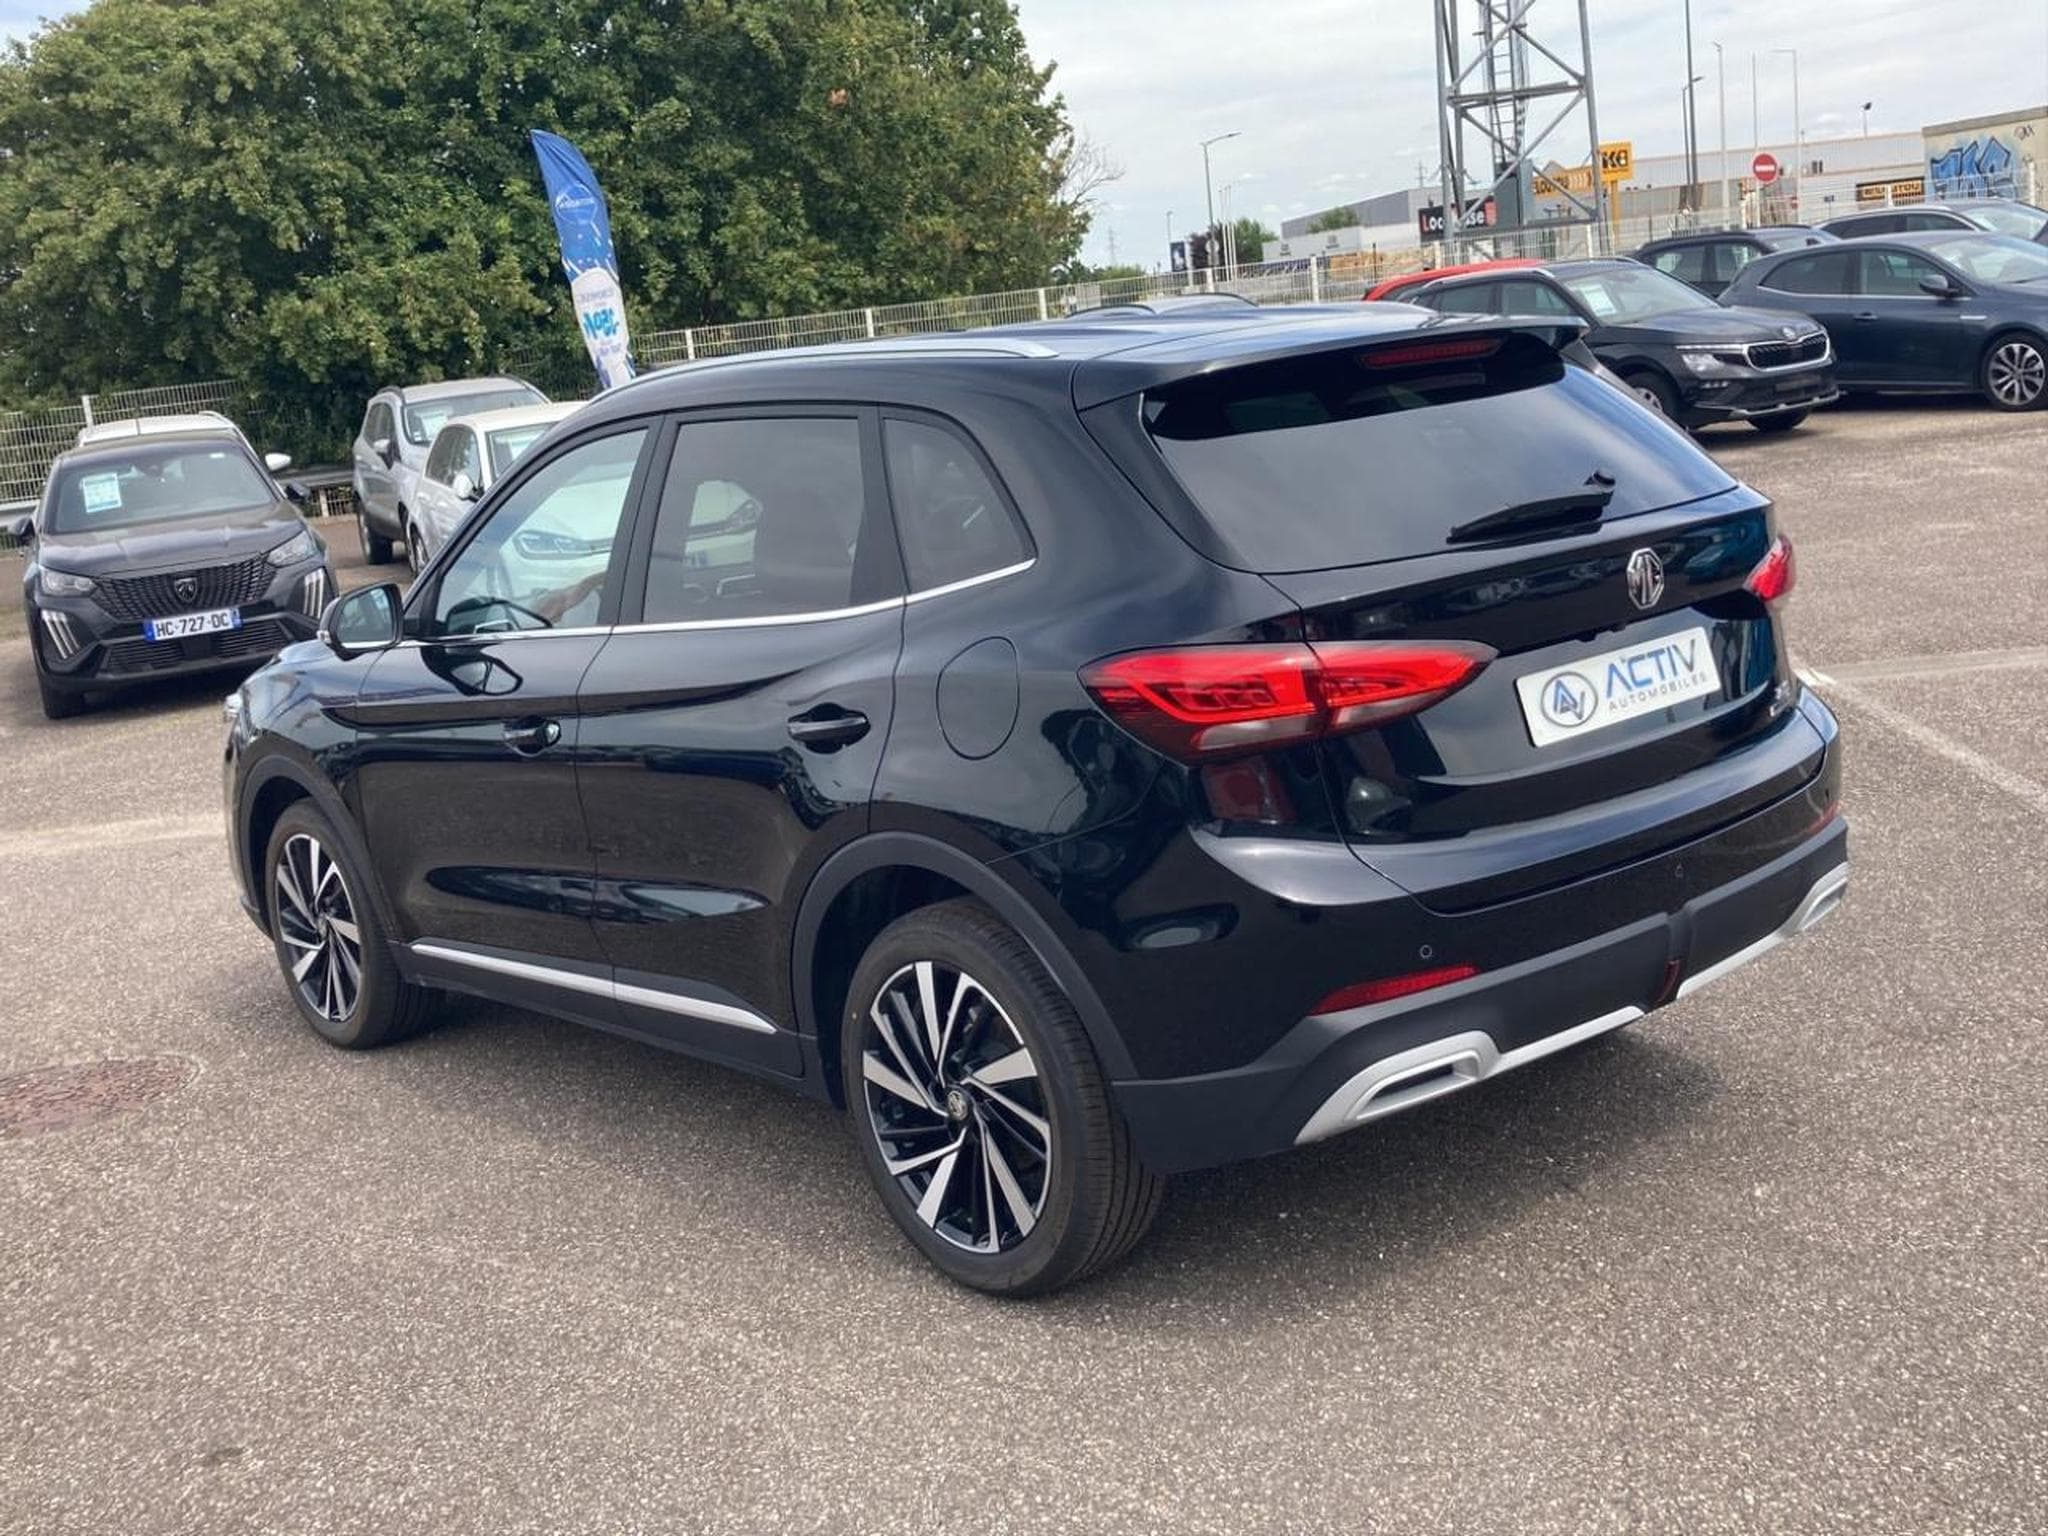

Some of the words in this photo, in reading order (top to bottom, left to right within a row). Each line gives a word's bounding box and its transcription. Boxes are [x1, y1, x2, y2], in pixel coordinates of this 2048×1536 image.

[156, 612, 229, 637] HC-727-DC
[1606, 639, 1695, 698] ACTIV
[1608, 671, 1707, 711] AUTOMOBILES
